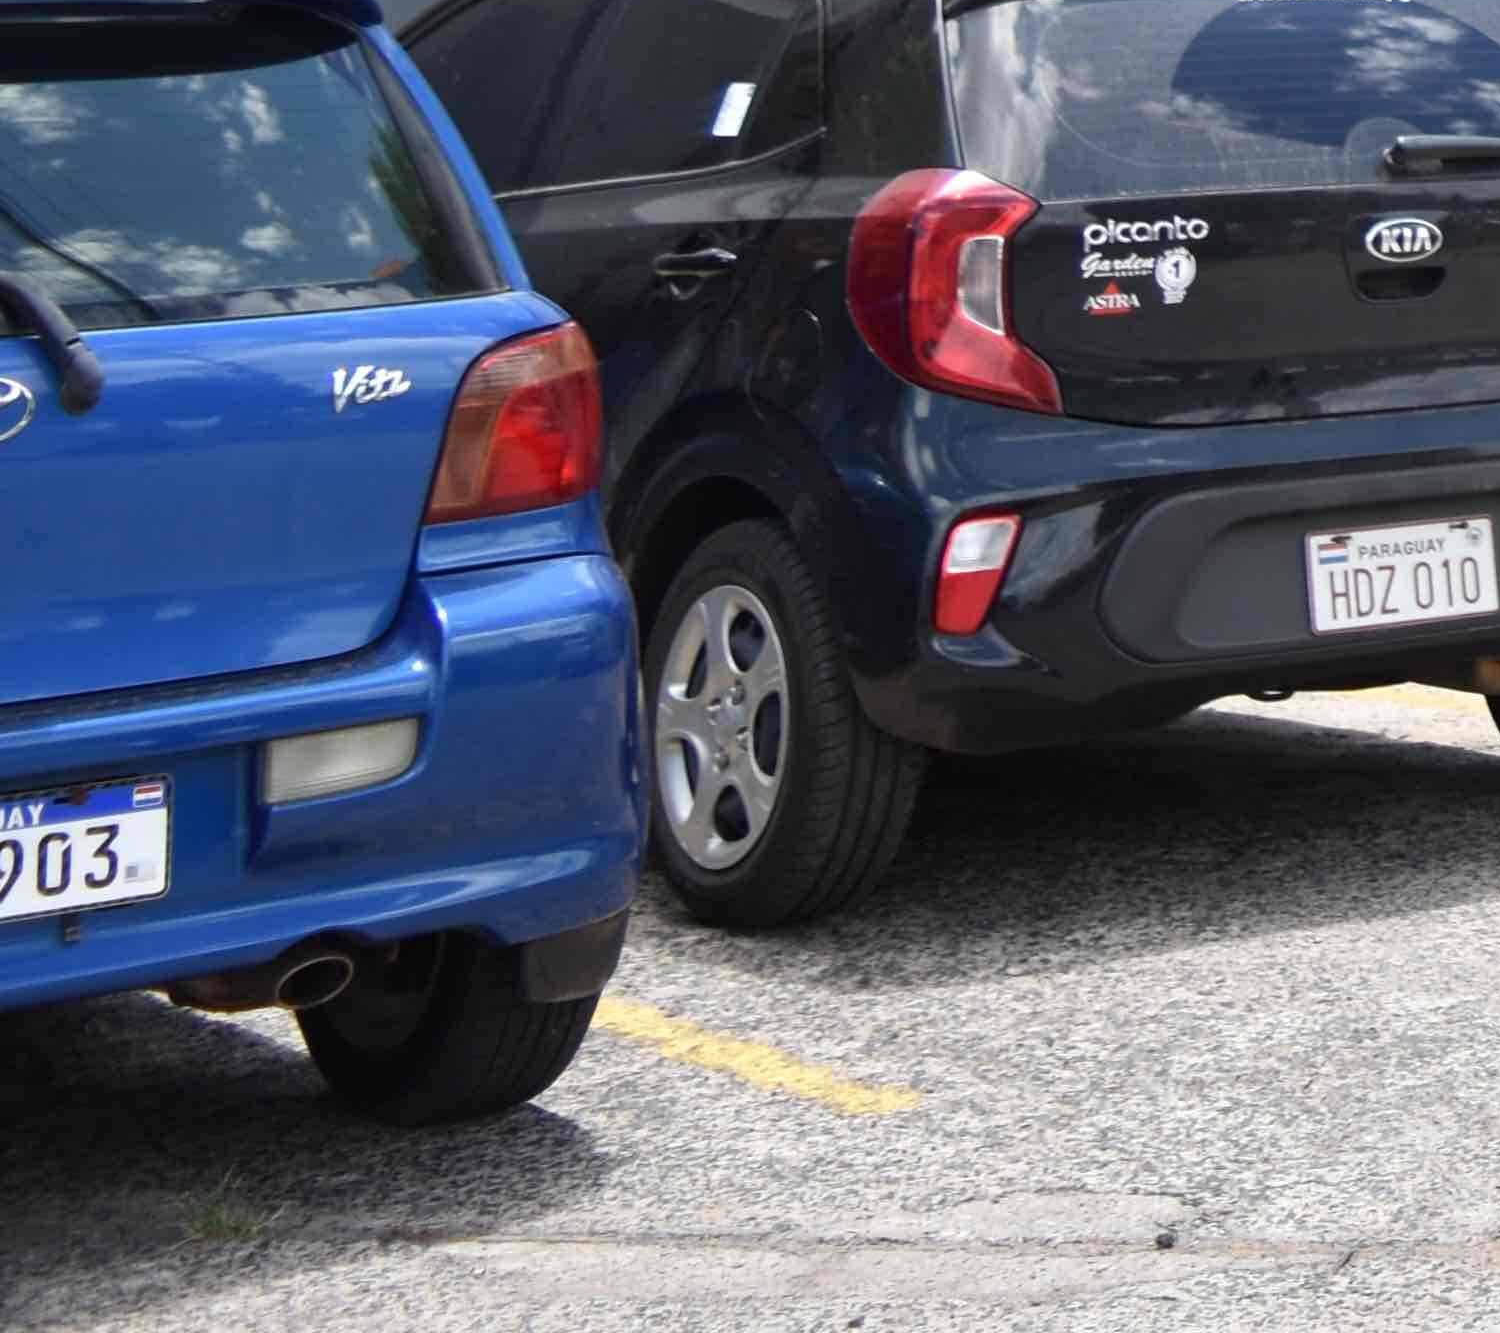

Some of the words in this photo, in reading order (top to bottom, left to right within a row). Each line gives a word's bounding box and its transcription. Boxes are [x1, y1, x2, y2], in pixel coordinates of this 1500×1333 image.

[1083, 215, 1209, 253] picanto
[1381, 227, 1433, 253] KIA
[1081, 252, 1155, 278] Garden
[1083, 293, 1141, 310] ASTRA
[333, 365, 412, 413] Vitz
[1358, 538, 1447, 561] PARAGUAY
[1329, 564, 1399, 620] HDZ
[1414, 557, 1481, 610] 010
[0, 803, 44, 831] AY
